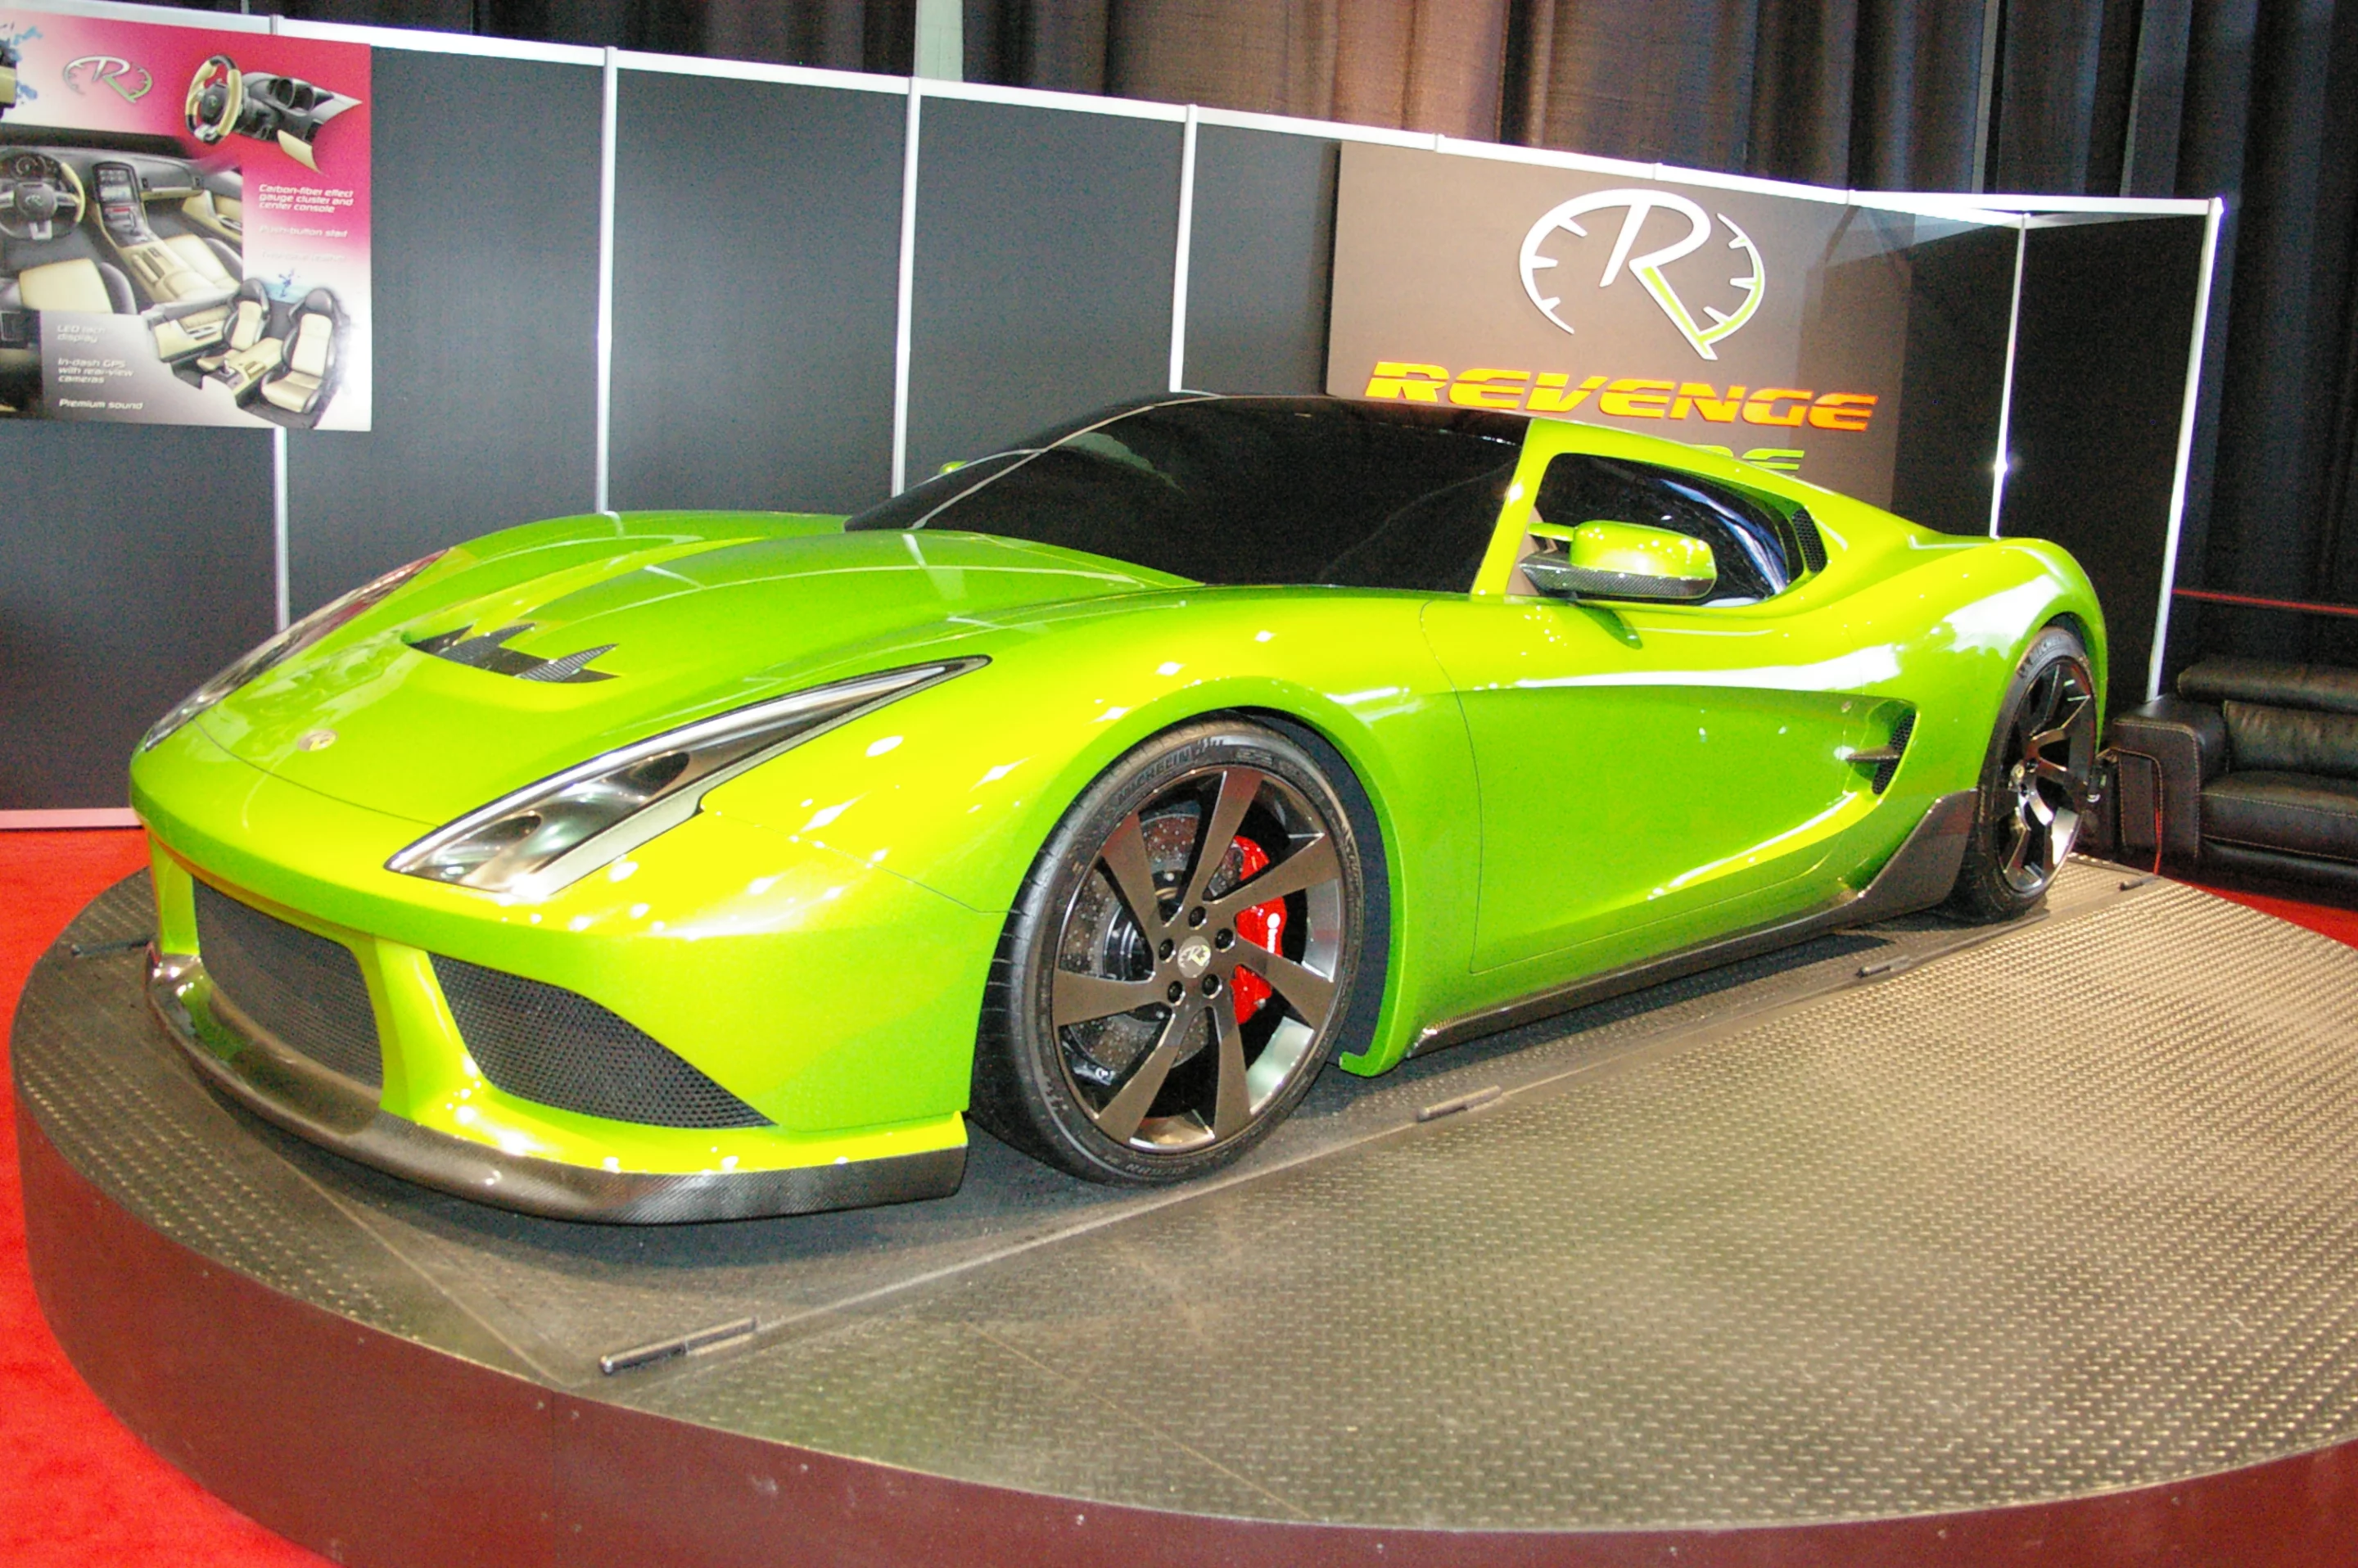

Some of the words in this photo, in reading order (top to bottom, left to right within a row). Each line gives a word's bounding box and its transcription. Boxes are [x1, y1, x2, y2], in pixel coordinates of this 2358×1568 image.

[259, 184, 323, 196] Carbon-fiber
[324, 189, 354, 197] effect
[259, 193, 294, 203] gauge
[296, 196, 330, 205] cluster
[332, 197, 354, 206] and
[259, 201, 291, 210] center
[293, 203, 335, 213] console
[325, 229, 348, 237] start
[57, 324, 80, 333] LED
[57, 332, 97, 343] display
[58, 358, 100, 368] In-dash
[102, 359, 126, 368] GPS
[58, 366, 81, 374] with
[83, 368, 133, 377] rear-view
[58, 375, 105, 384] cameras
[1365, 360, 1879, 431] REVENGE
[59, 399, 106, 409] Premium
[107, 401, 144, 410] sound
[1114, 744, 1193, 802] MICHELIN
